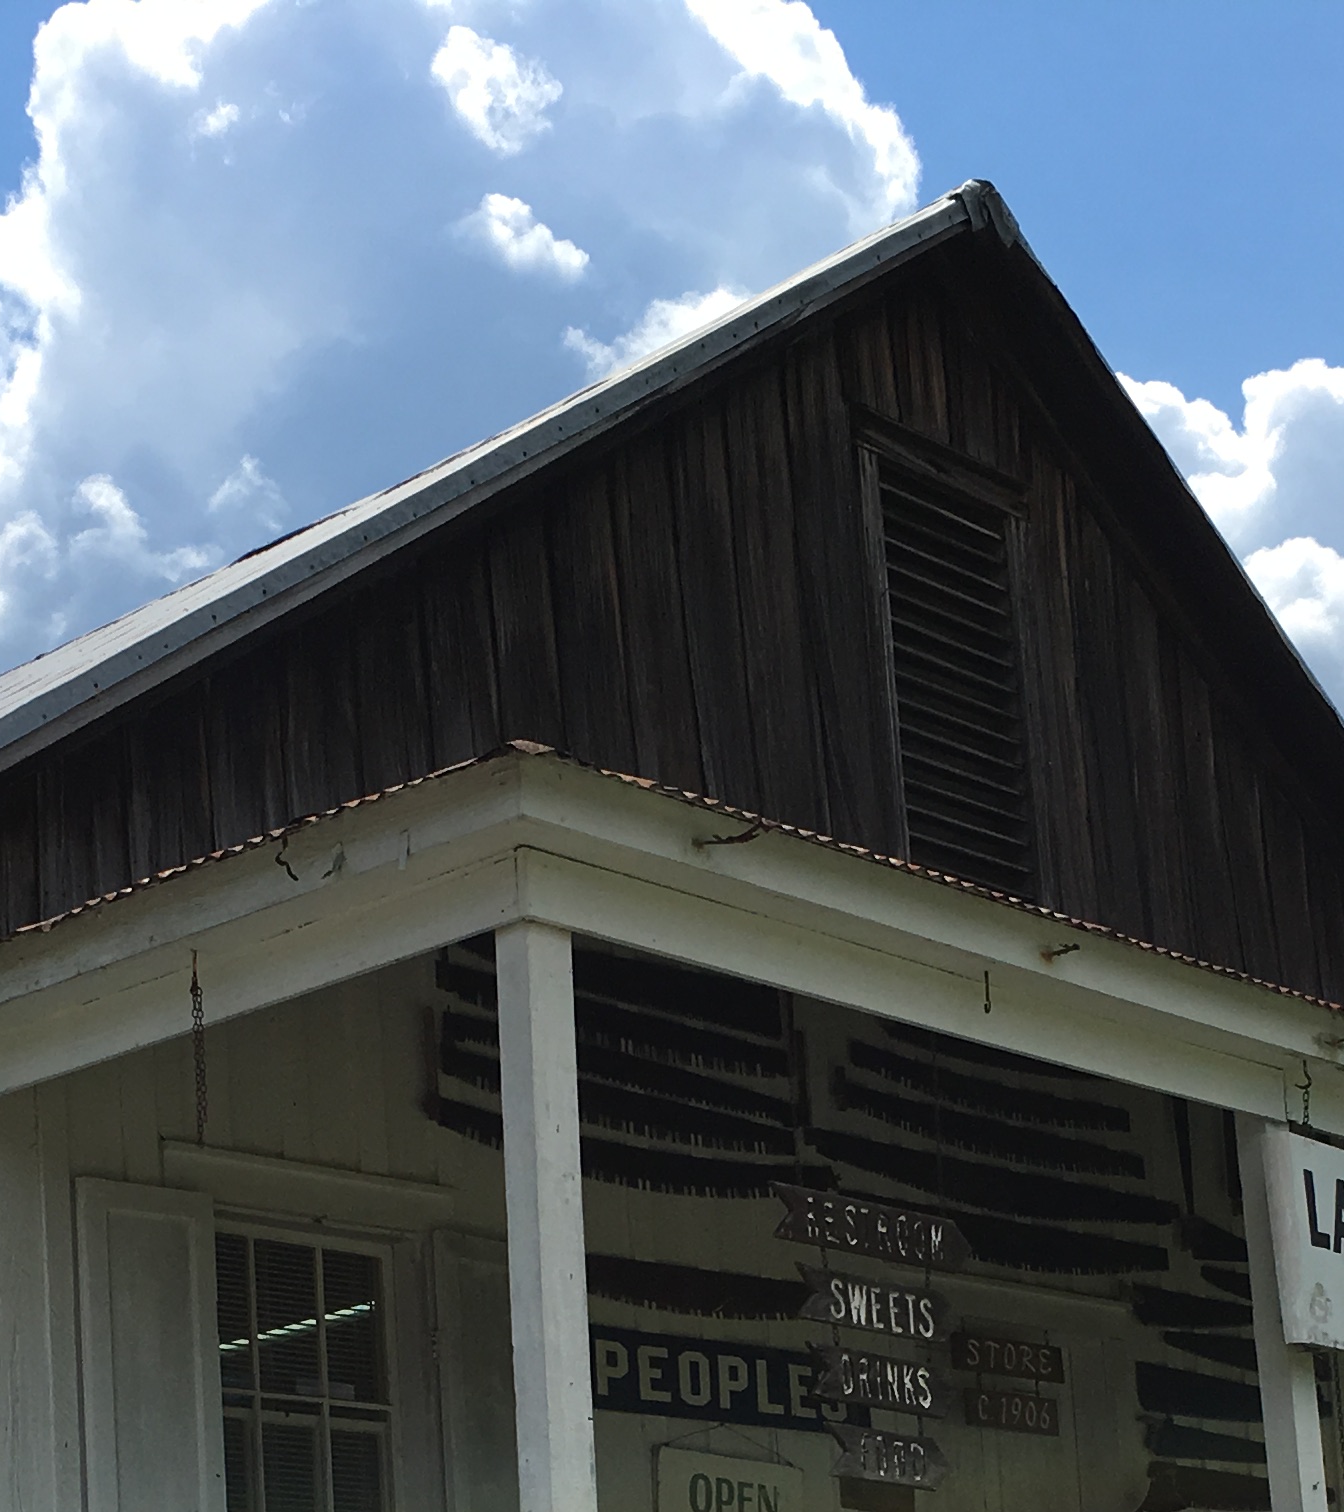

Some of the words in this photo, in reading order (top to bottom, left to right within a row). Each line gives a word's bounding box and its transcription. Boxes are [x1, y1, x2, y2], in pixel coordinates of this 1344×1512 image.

[807, 1195, 945, 1261] RESTROOM
[829, 1278, 935, 1339] SWEETS
[841, 1353, 934, 1410] DRINKS
[966, 1338, 1053, 1376] STORE
[1001, 1397, 1051, 1429] 1906
